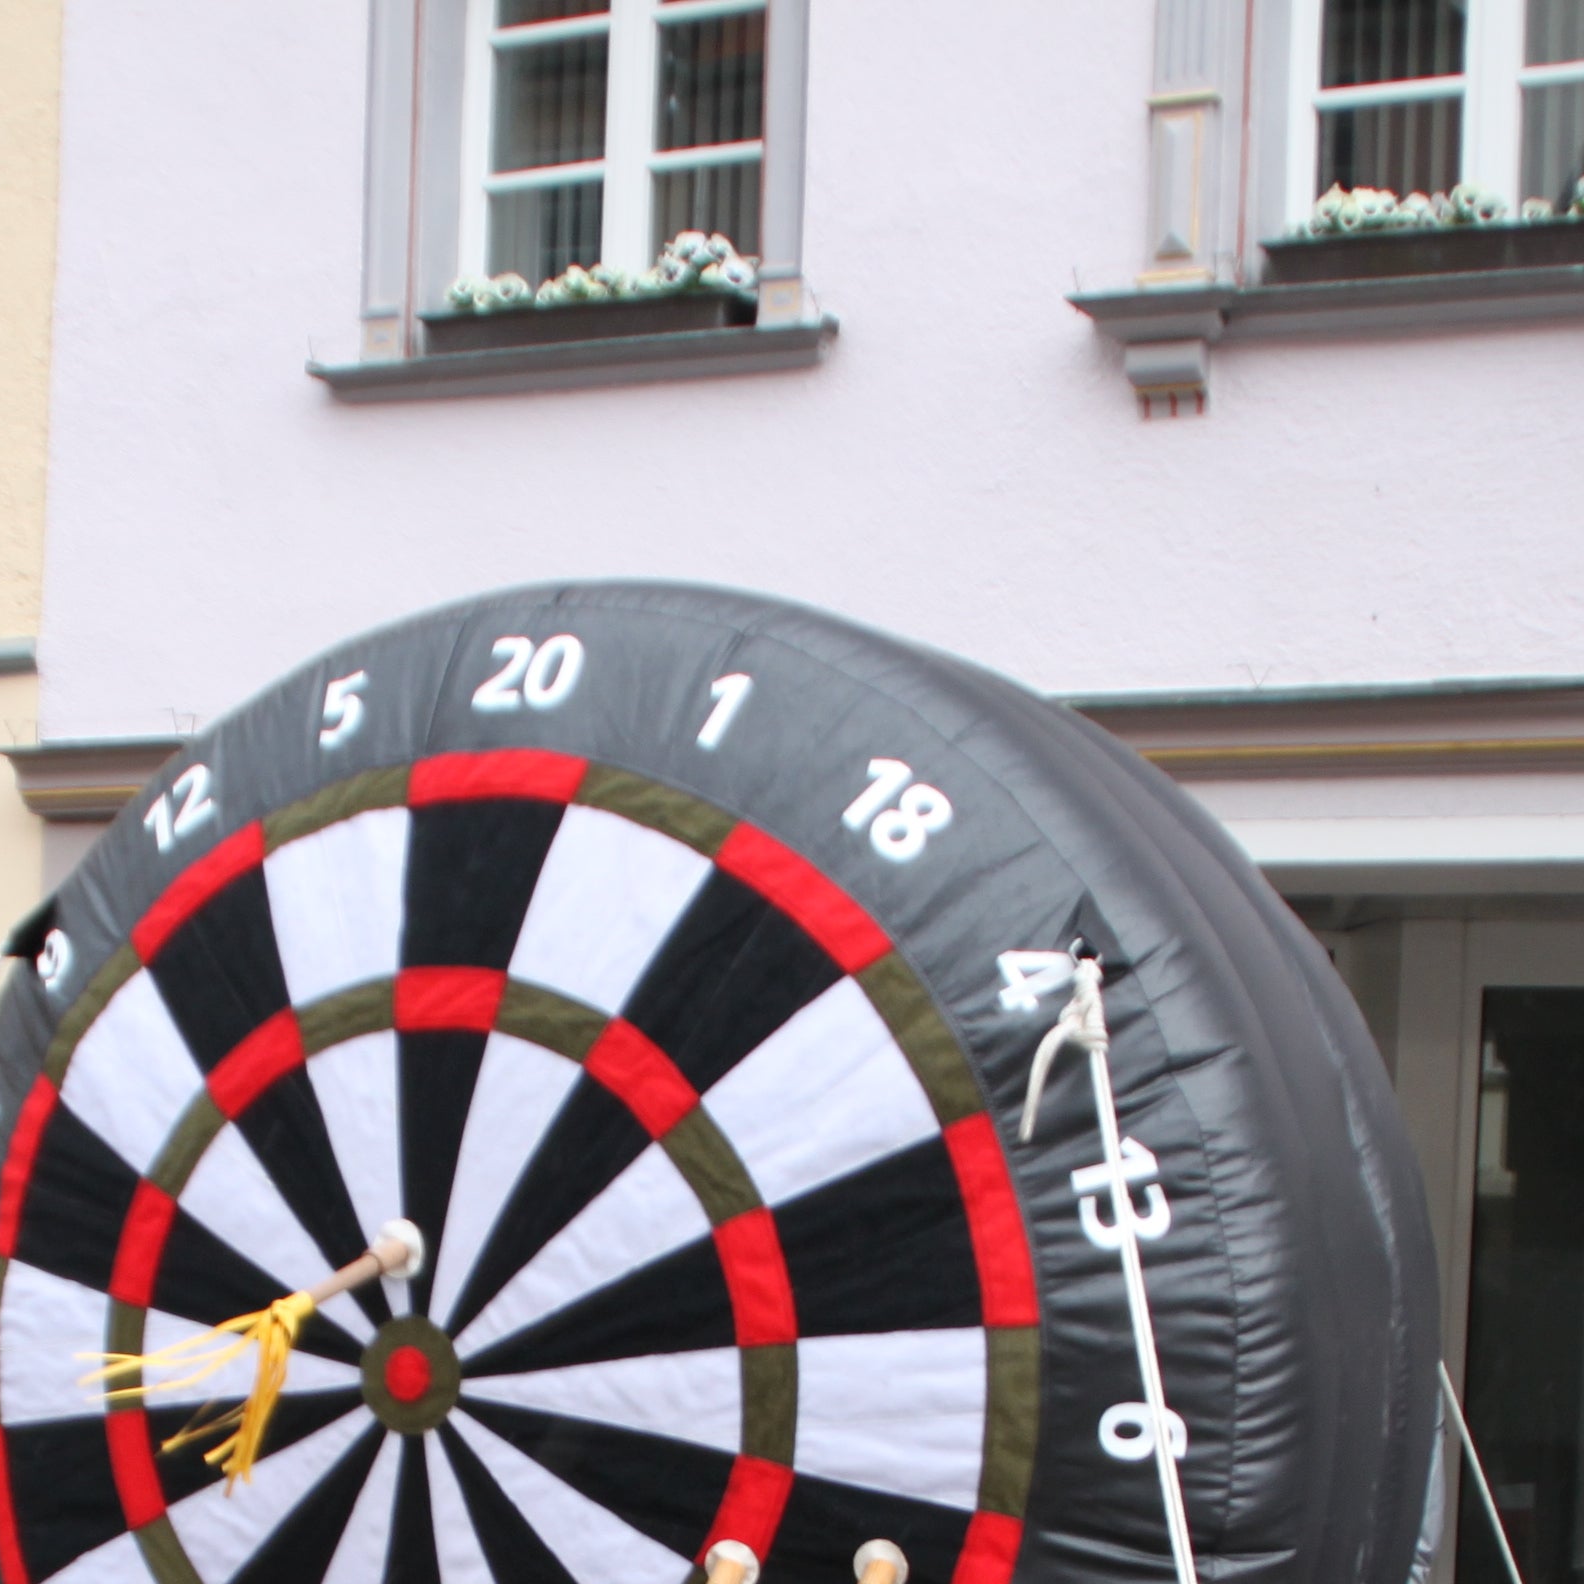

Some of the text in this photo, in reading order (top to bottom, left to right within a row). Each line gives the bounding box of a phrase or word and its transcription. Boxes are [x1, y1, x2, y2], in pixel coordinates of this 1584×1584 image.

[318, 669, 369, 751] 5
[471, 633, 585, 713] 20
[695, 671, 754, 752] 1
[143, 763, 216, 856] 12
[840, 757, 954, 865] 18
[35, 927, 74, 993] 9
[996, 949, 1076, 1015] 4
[1070, 1135, 1172, 1251] 13
